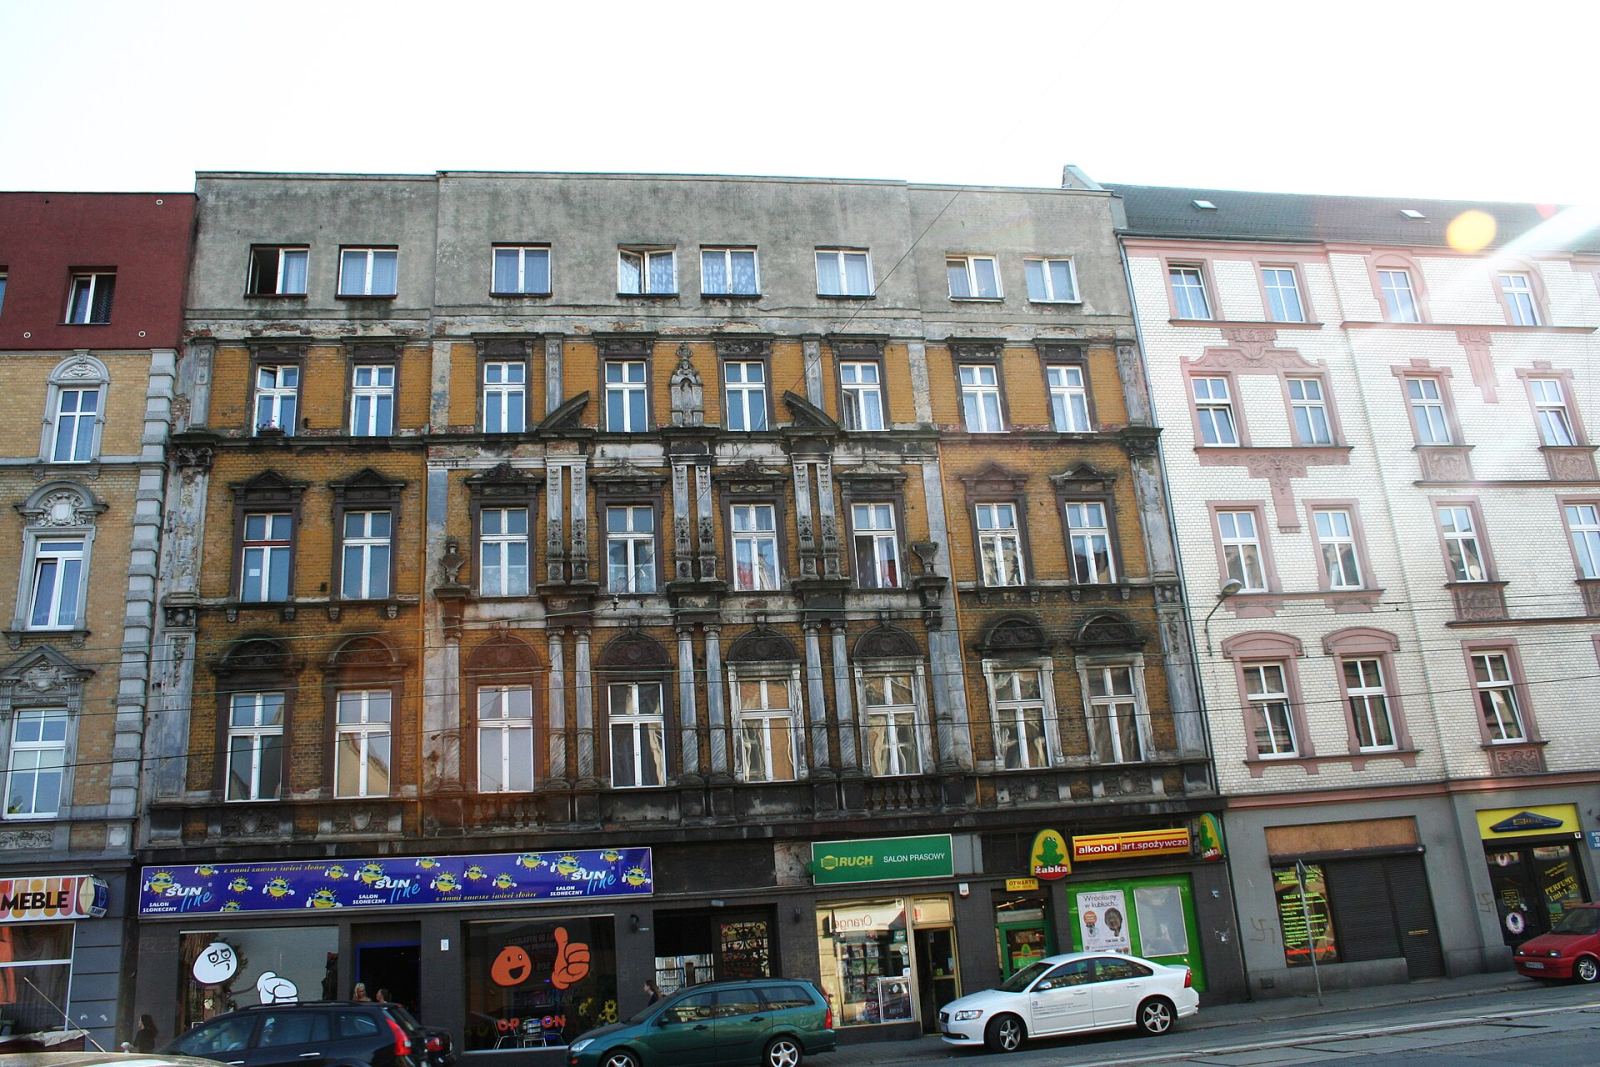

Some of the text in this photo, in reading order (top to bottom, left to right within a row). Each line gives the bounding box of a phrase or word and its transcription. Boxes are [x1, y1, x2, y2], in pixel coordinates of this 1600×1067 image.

[1078, 843, 1118, 854] alkohol
[839, 852, 945, 867] RUCH SALON PRASOWY
[571, 870, 606, 880] SUN
[1035, 864, 1068, 875] żabka
[374, 879, 411, 889] SUN
[587, 872, 616, 894] line
[165, 886, 203, 897] SUN
[390, 880, 420, 904] line
[0, 890, 70, 911] MEBLE
[180, 889, 212, 912] line
